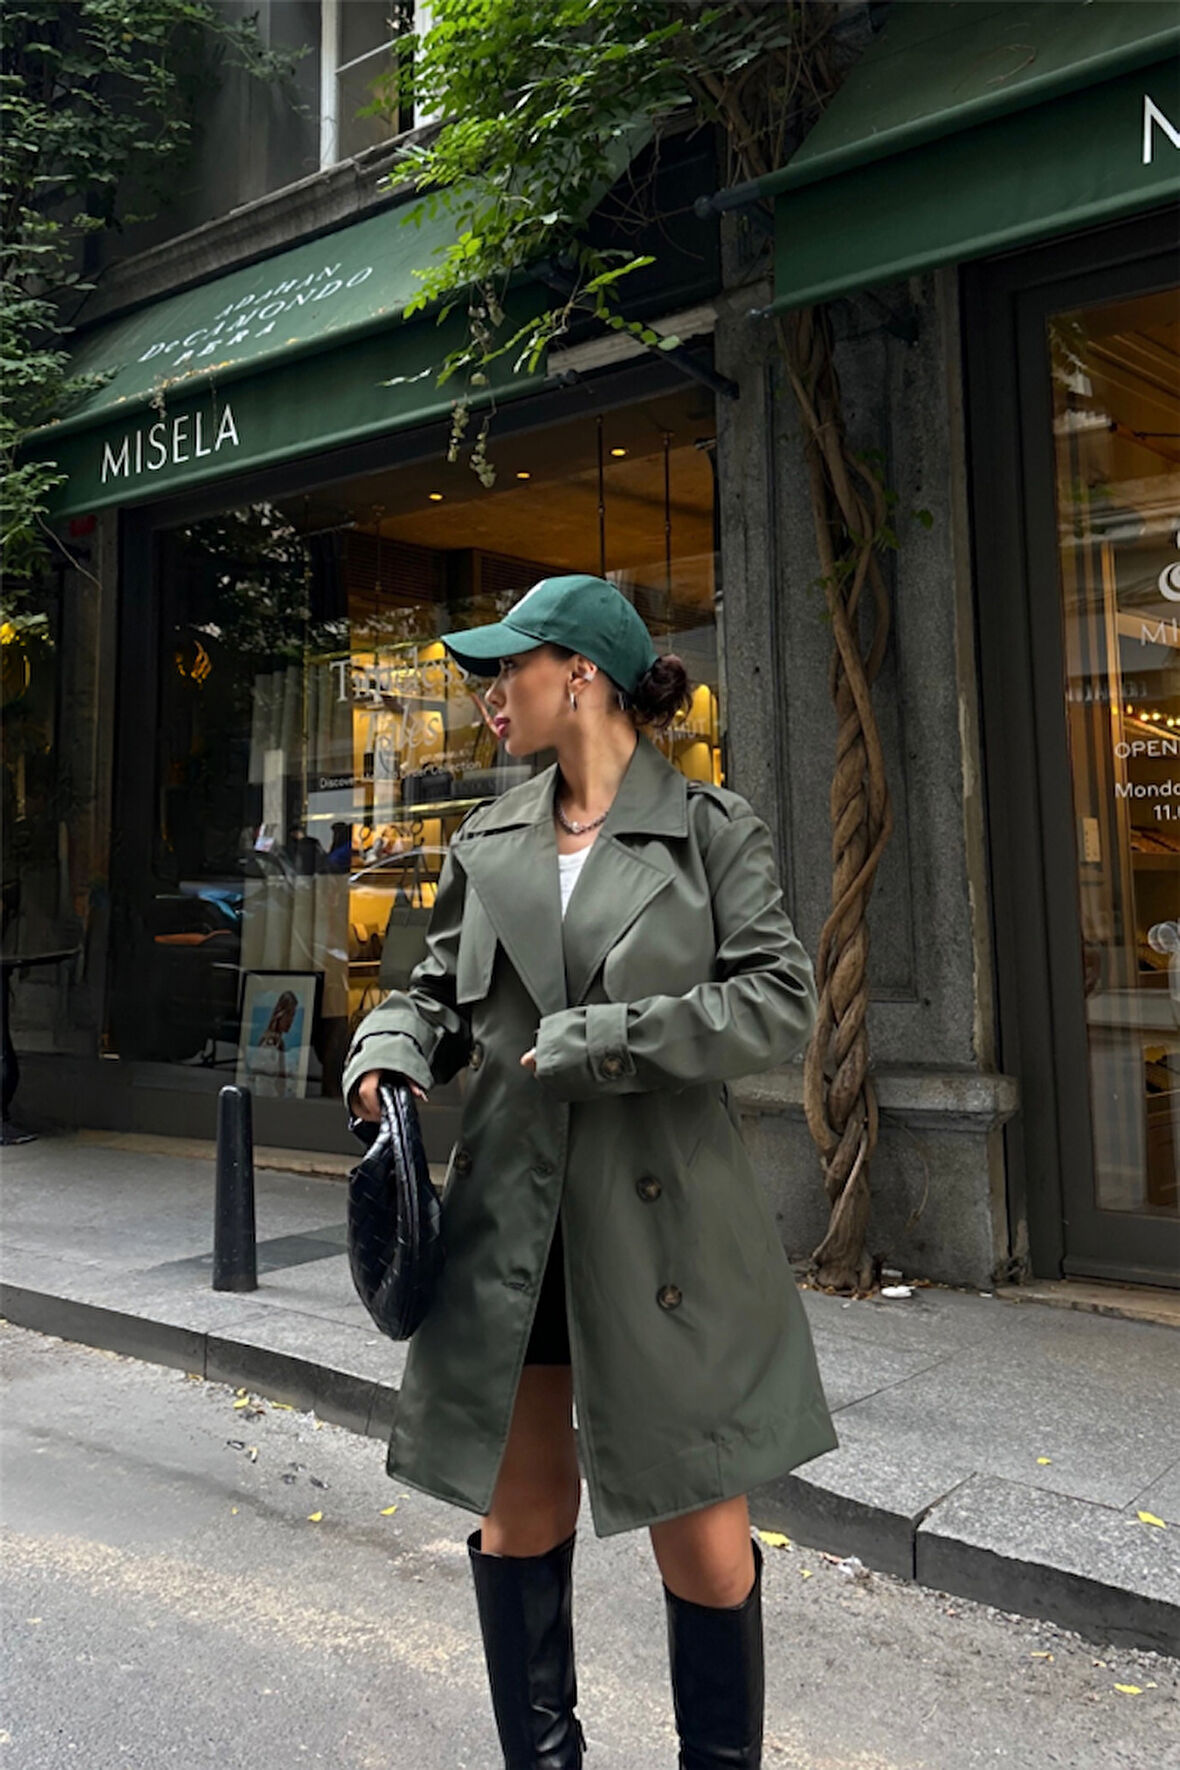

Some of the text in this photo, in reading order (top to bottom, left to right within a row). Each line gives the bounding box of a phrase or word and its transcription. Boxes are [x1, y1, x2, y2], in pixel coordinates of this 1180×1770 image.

[213, 262, 342, 321] ADAHAN
[101, 403, 240, 484] MISELA
[1114, 739, 1178, 759] OPEN
[1153, 804, 1180, 822] 11.
